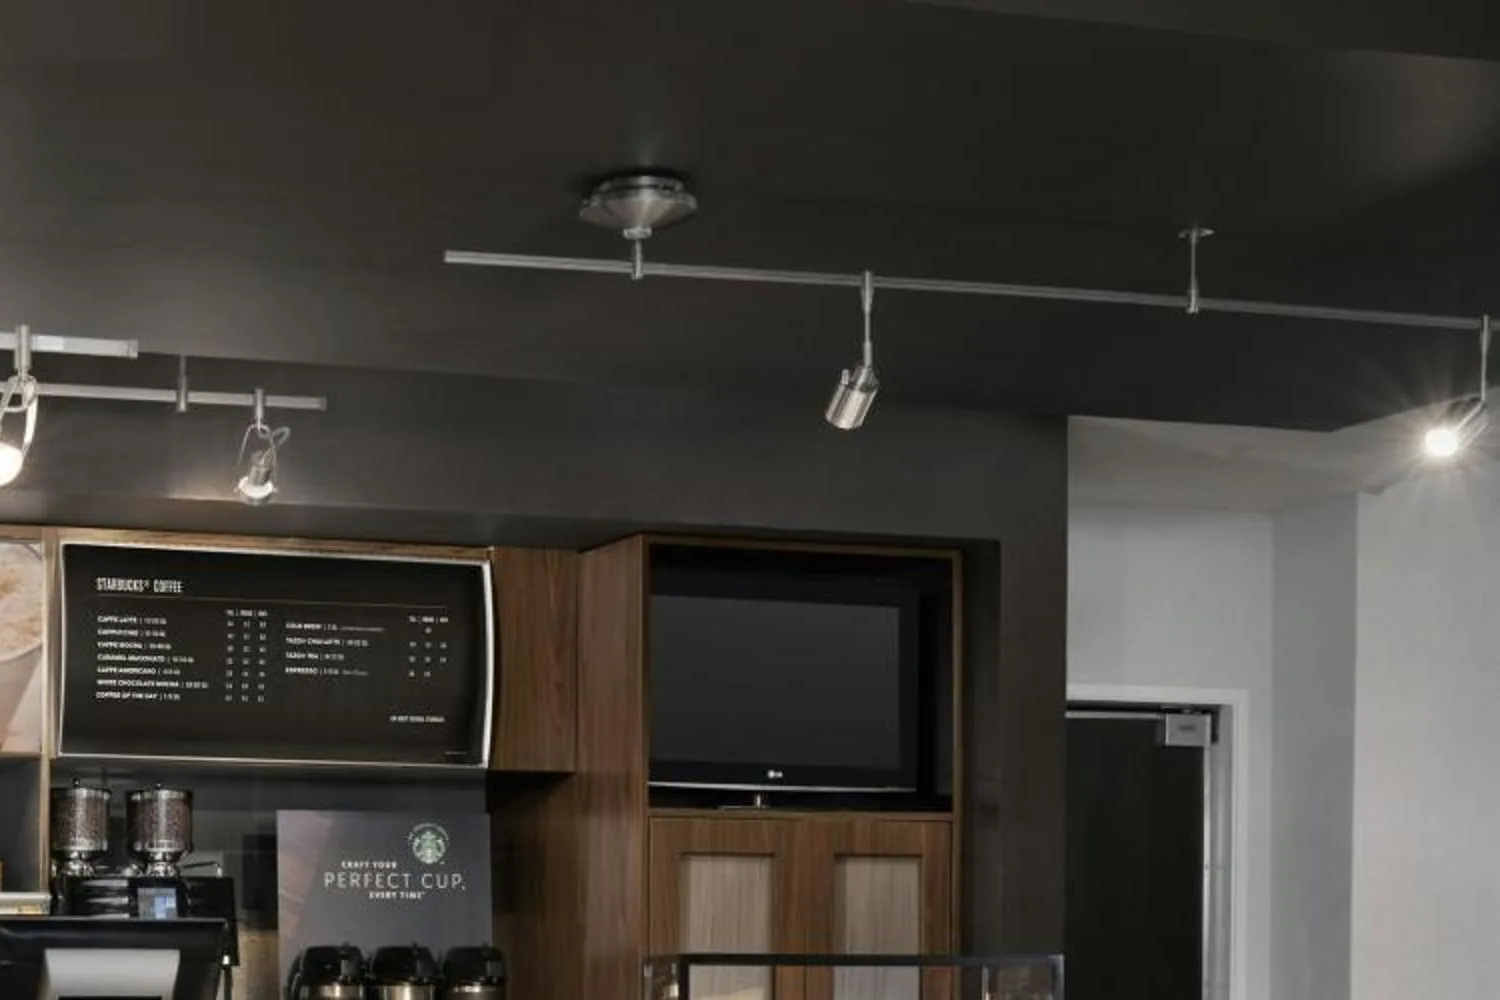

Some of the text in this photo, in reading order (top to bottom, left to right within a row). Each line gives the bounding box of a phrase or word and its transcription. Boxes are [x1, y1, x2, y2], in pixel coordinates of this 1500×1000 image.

[153, 579, 183, 593] COFFEE
[341, 861, 398, 869] CRAFT YOUR
[323, 872, 411, 889] PERFECT
[368, 891, 398, 900] EVERY
